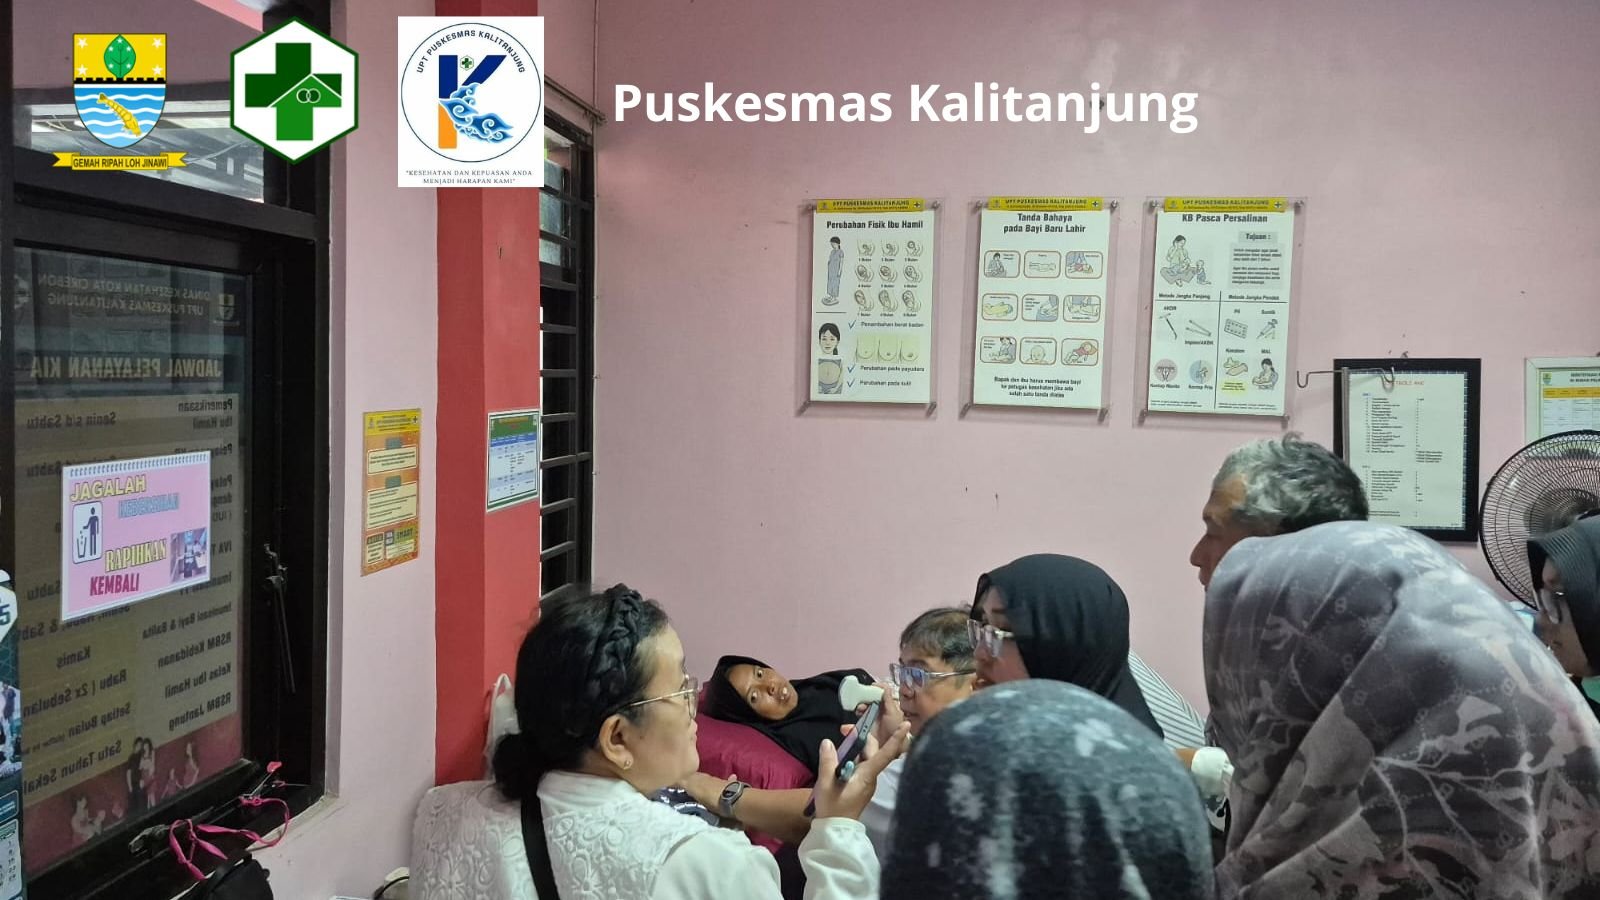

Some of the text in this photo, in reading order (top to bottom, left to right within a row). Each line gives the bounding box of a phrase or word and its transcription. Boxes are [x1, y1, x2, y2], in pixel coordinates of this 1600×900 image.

[1017, 213, 1073, 223] Tanda Bahaya
[1182, 213, 1268, 222] KB Pasca Persalinan
[827, 220, 924, 229] Perubahan Fisik Ibu Hamil
[1003, 225, 1086, 234] pada Bayi Baru Lahir
[1246, 233, 1267, 241] Tujuan
[70, 474, 147, 502] JAGALAH
[90, 573, 140, 596] KEMBALI
